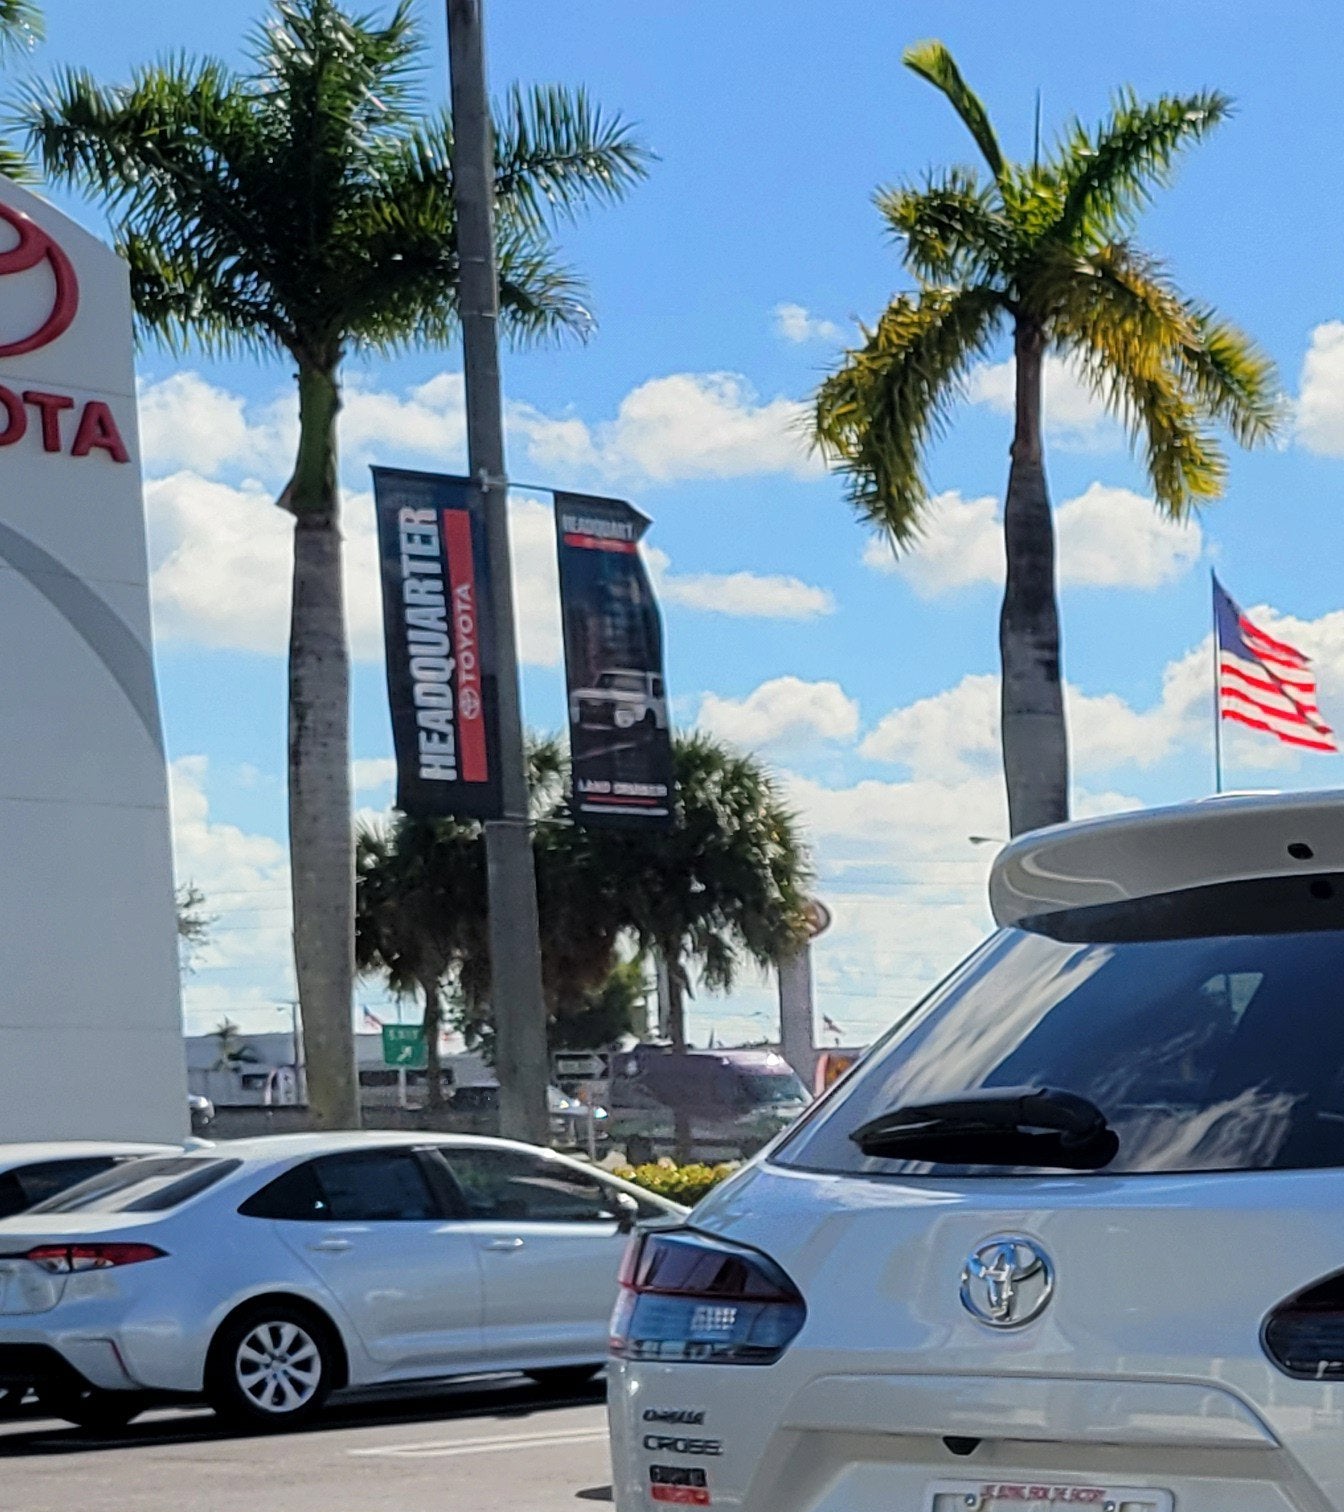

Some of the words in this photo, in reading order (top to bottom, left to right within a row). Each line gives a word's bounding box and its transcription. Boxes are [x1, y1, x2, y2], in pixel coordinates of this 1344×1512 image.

[399, 507, 457, 781] HEADQUARTER
[454, 583, 476, 683] TOYOTA
[643, 1434, 723, 1456] CROSS
